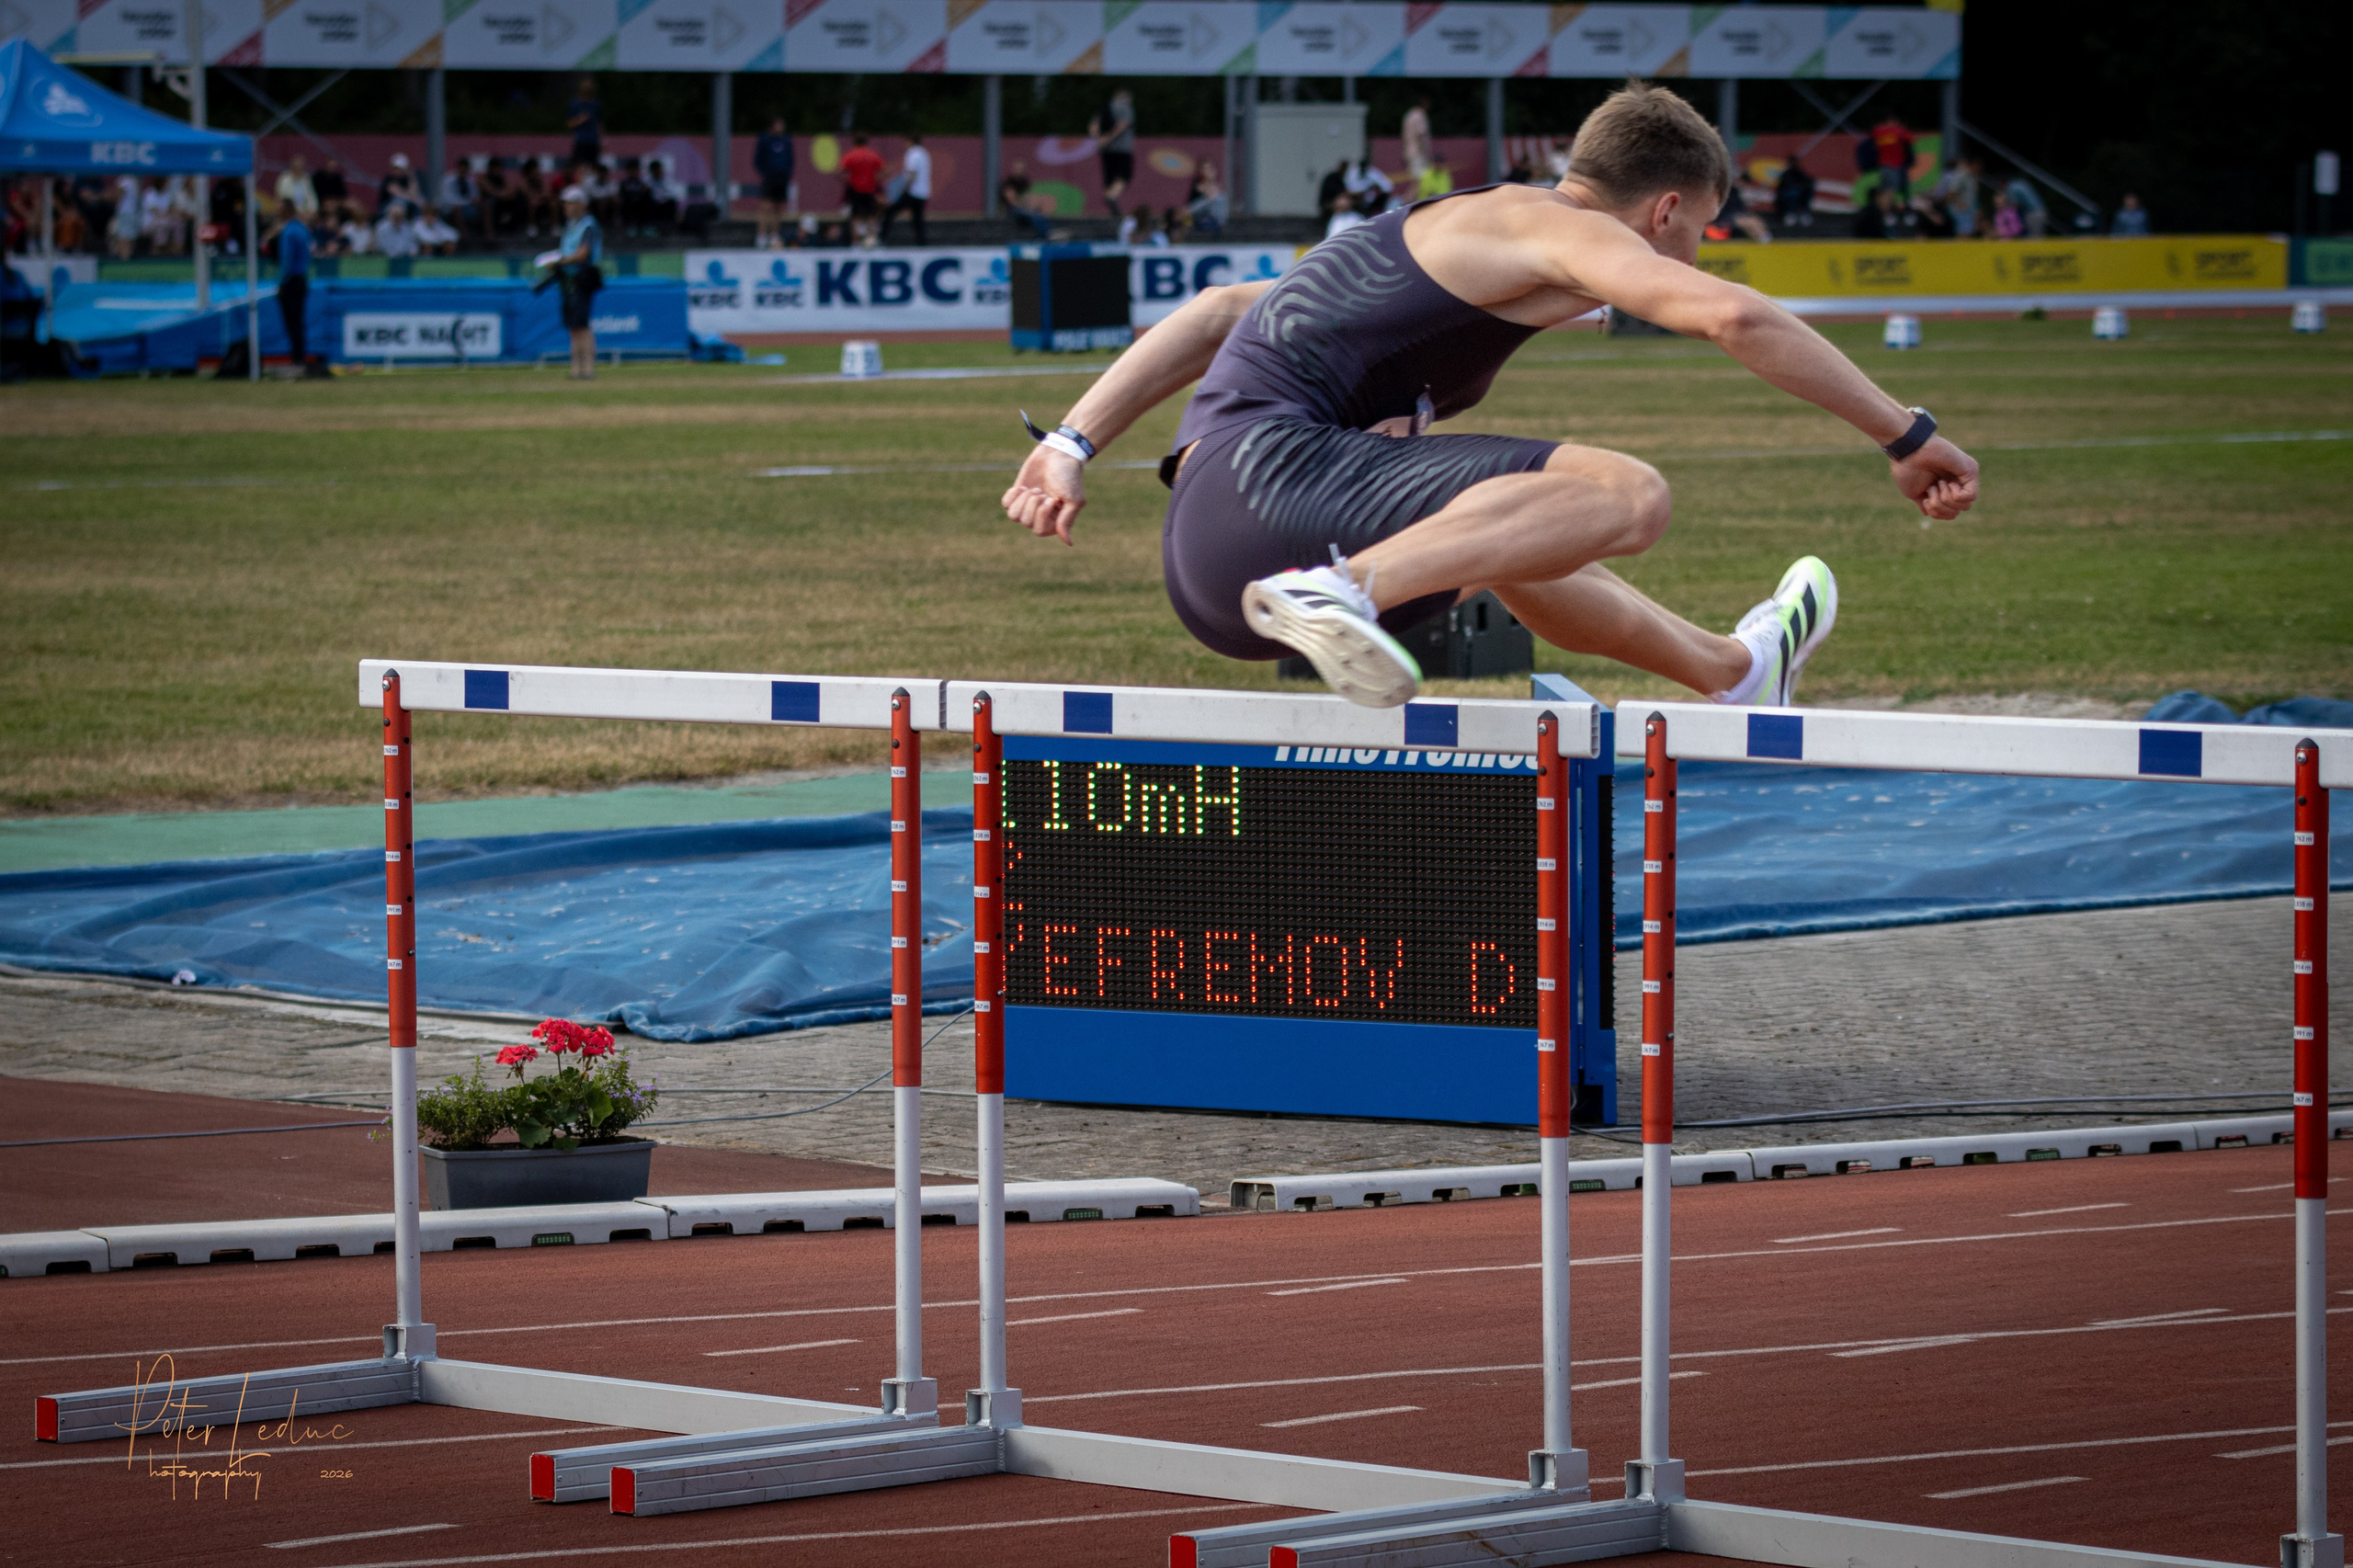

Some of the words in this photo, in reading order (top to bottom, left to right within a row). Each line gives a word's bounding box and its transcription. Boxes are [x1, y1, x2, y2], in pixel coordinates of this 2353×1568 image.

[816, 257, 961, 306] KBC
[975, 290, 1010, 305] KB
[1131, 256, 1233, 301] BC
[1471, 941, 1515, 1015] D
